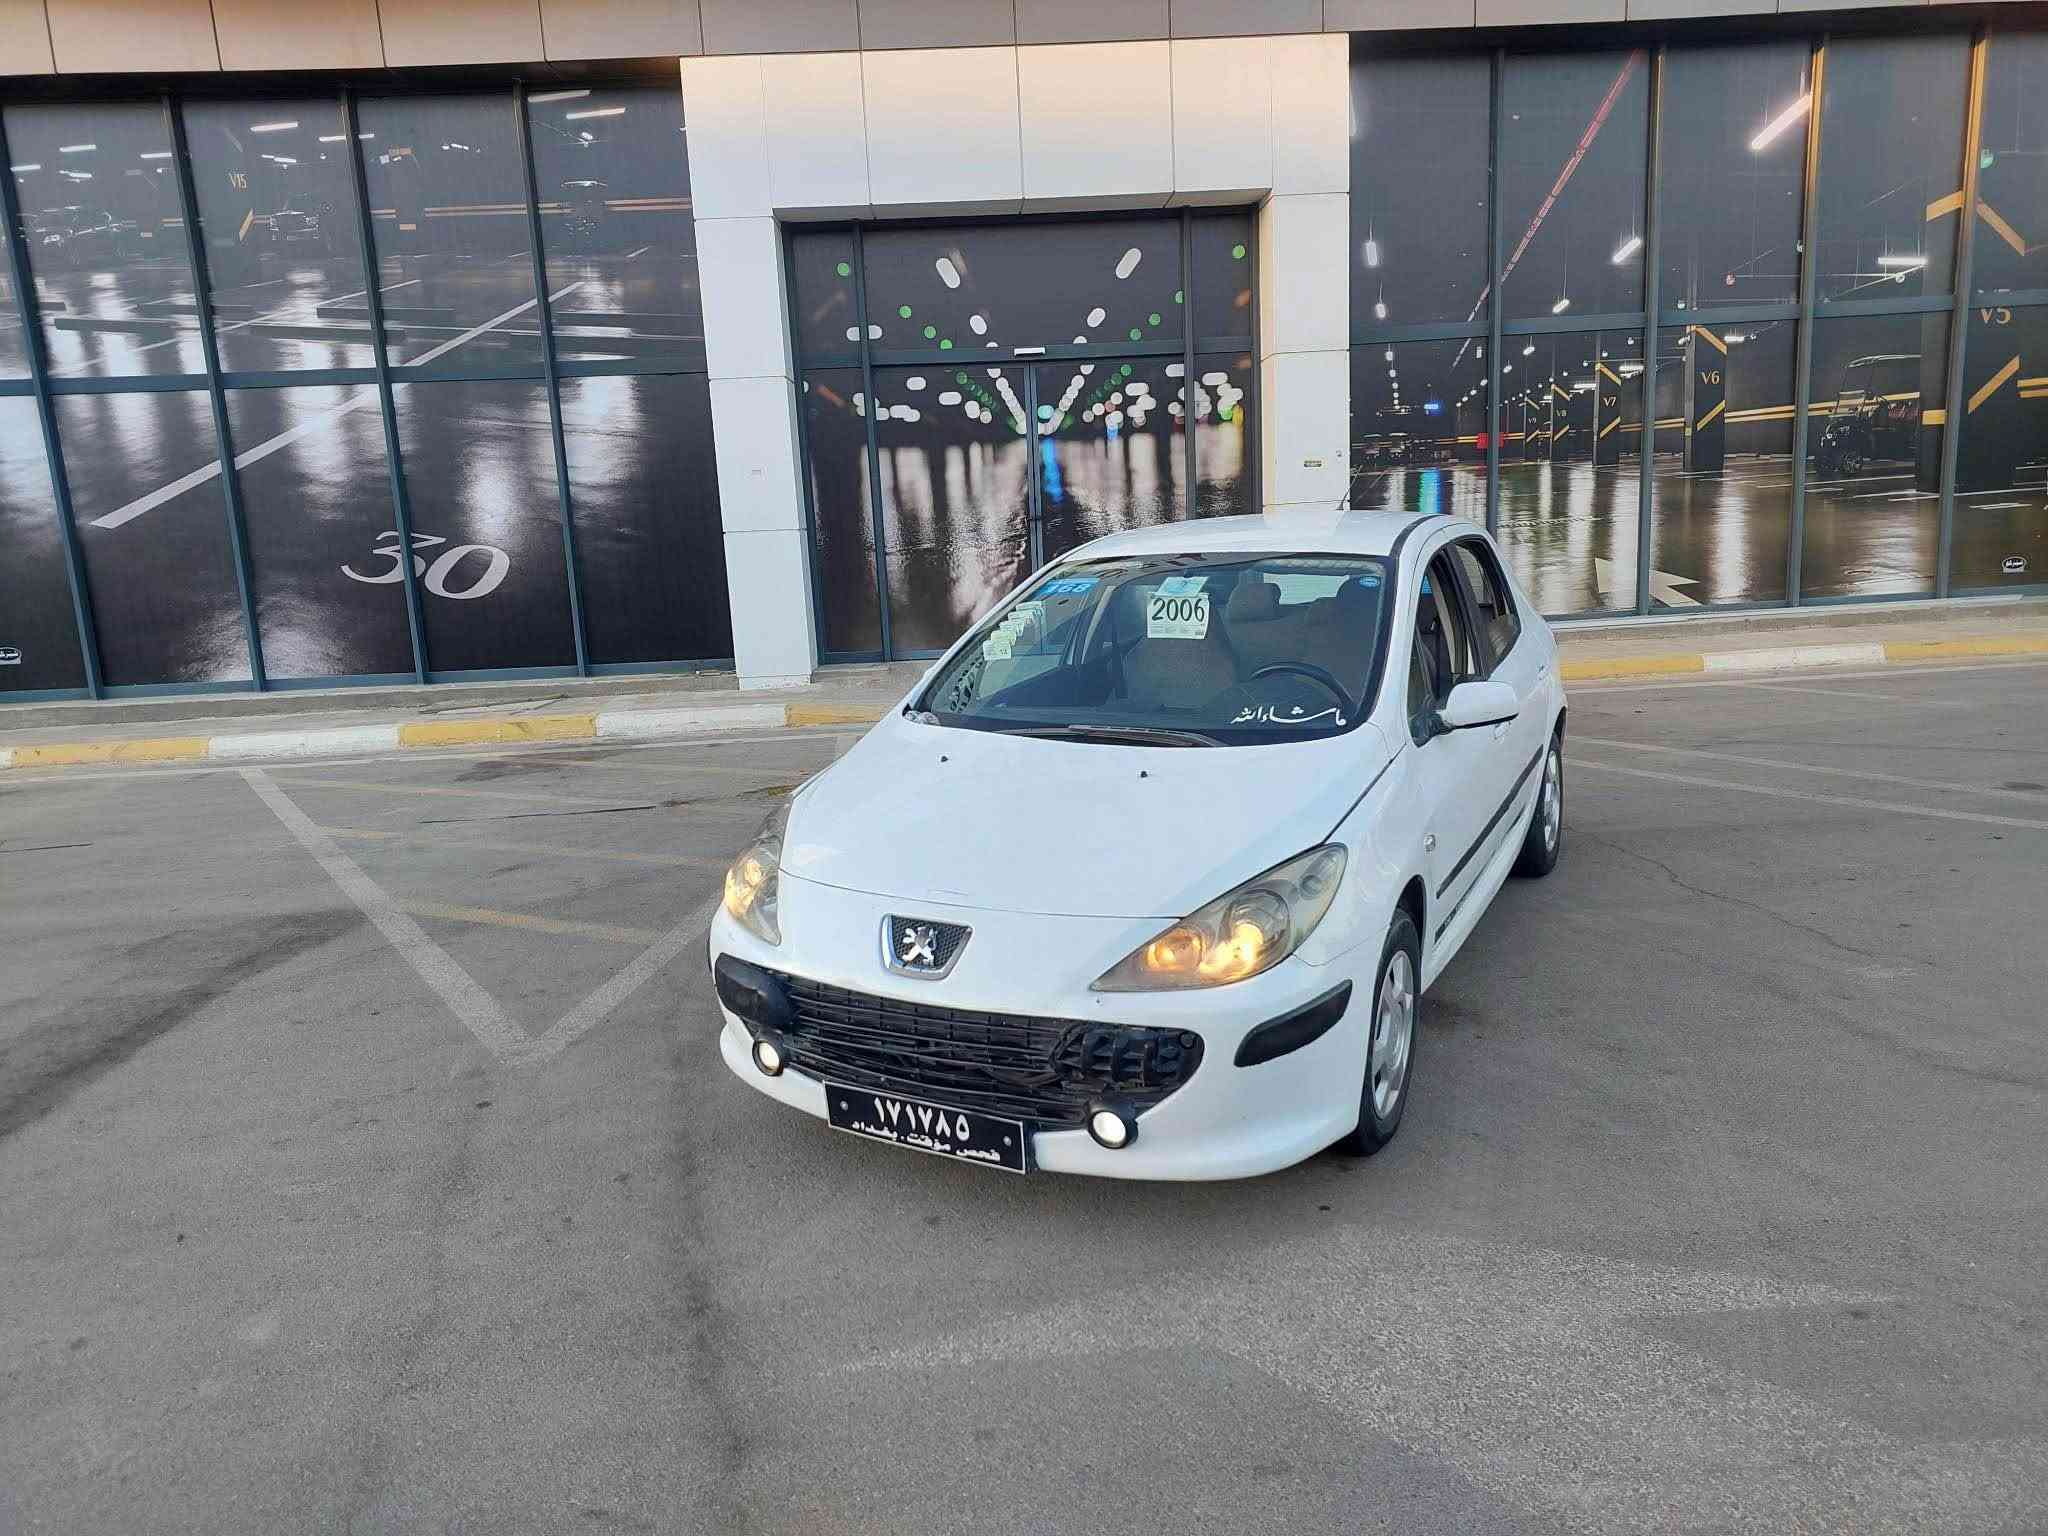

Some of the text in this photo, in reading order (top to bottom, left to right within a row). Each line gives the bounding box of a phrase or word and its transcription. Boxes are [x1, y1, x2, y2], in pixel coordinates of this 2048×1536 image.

[341, 531, 510, 599] 30
[1152, 598, 1204, 622] 2006
[874, 1097, 970, 1141] ١٧١٧٨٥
